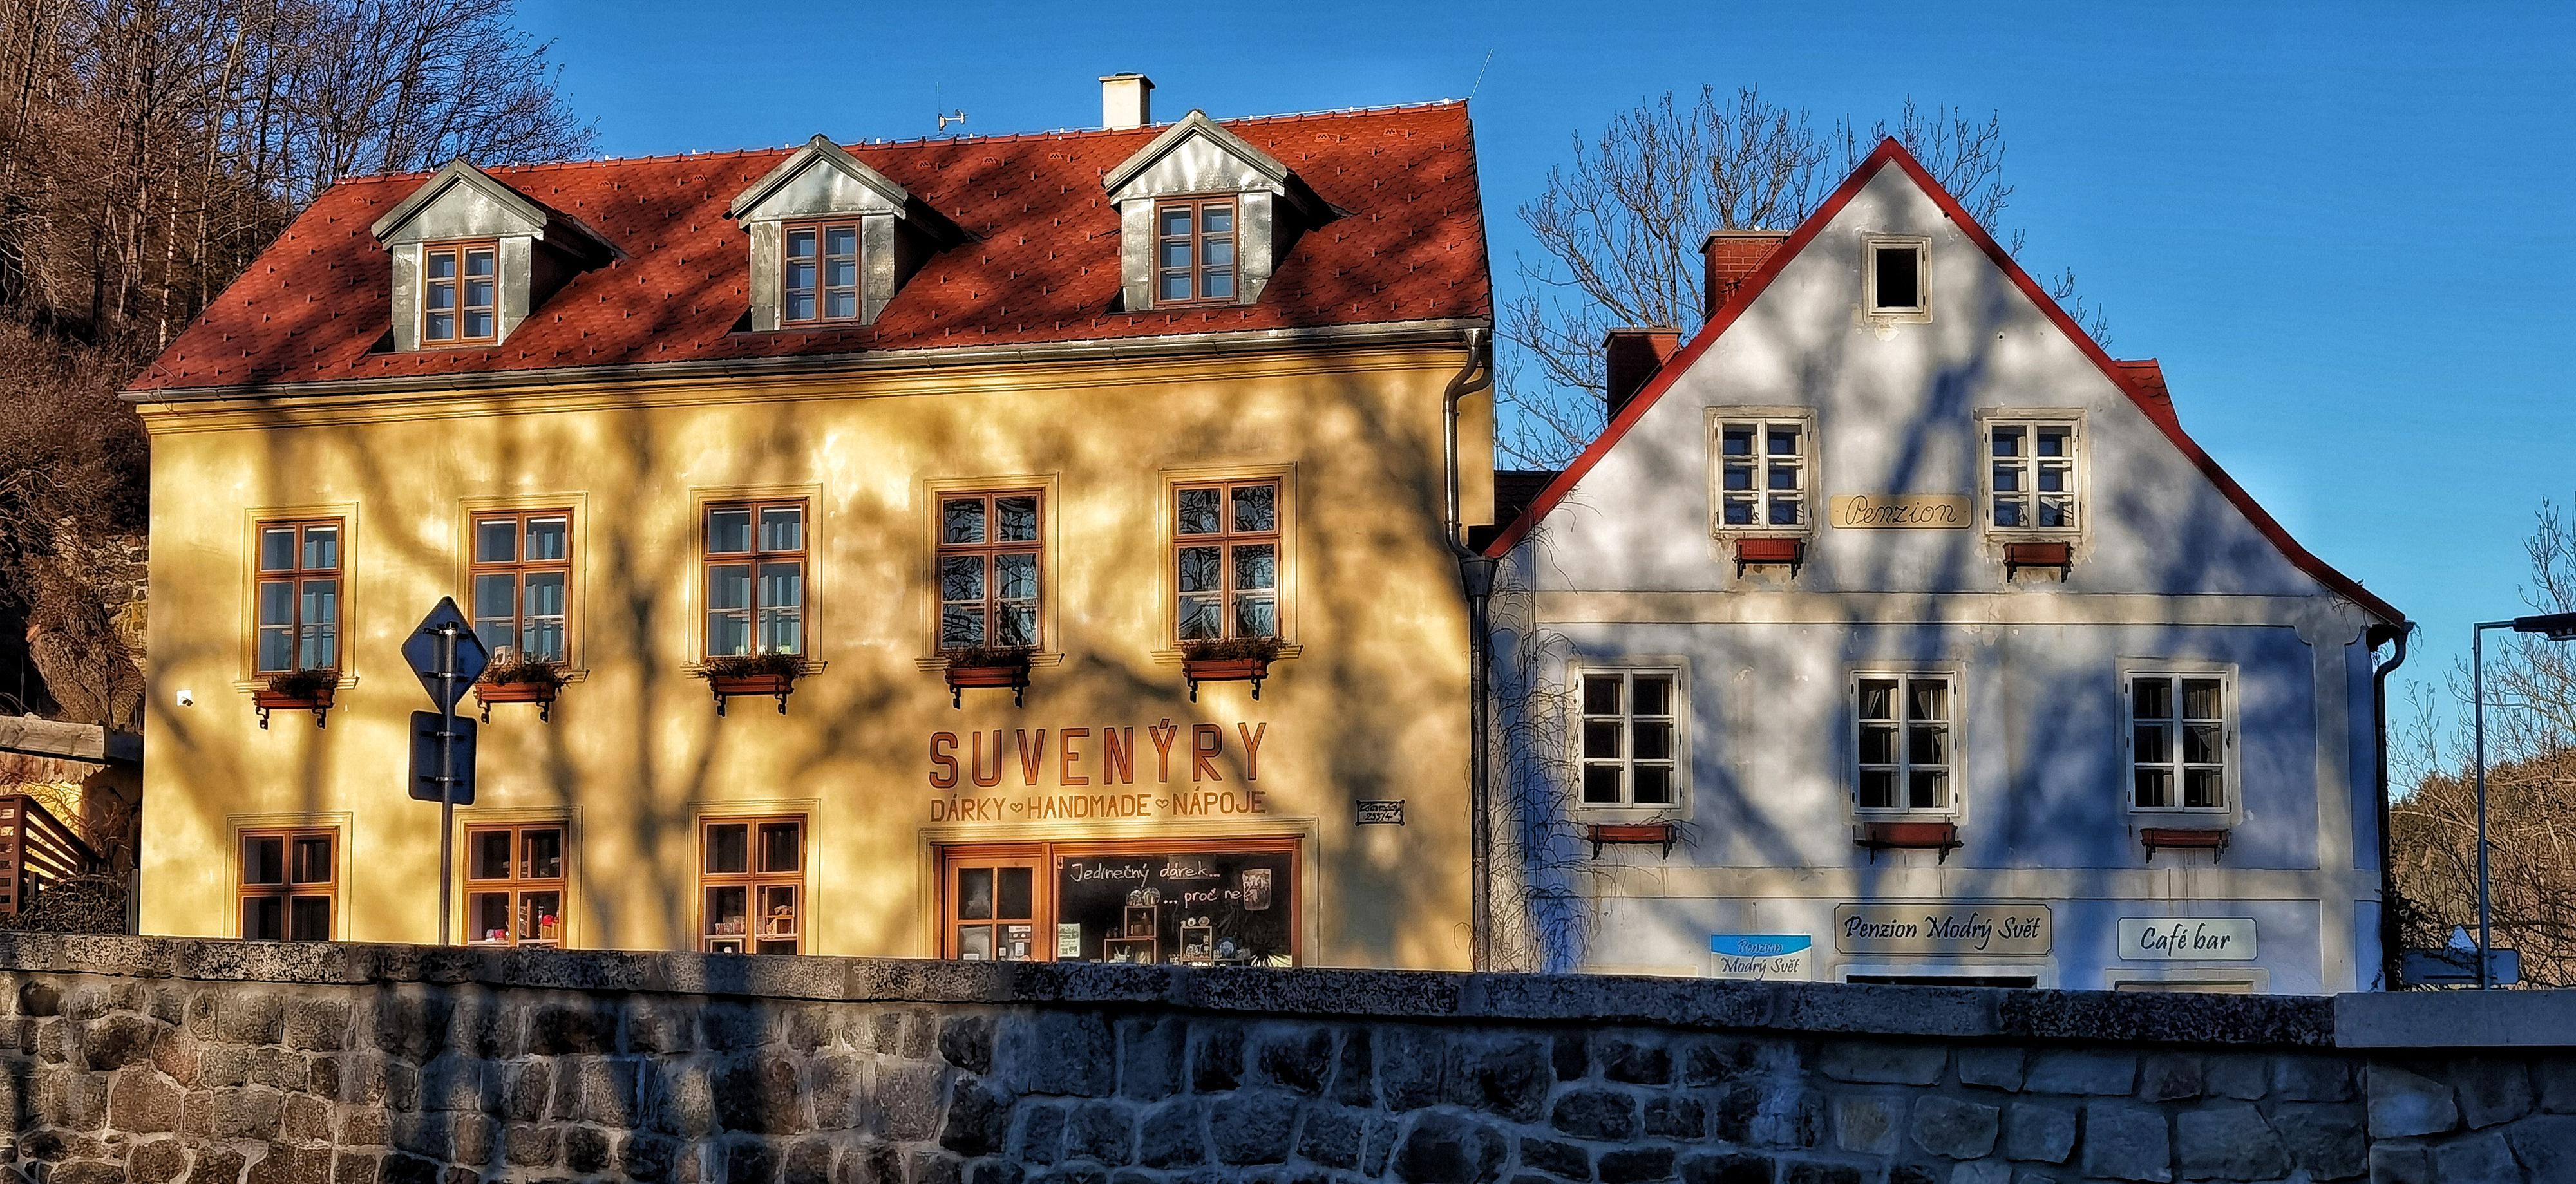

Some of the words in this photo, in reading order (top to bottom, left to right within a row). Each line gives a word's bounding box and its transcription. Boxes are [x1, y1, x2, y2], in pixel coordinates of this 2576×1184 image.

[1845, 495, 1957, 525] Penzion
[929, 719, 1266, 789] SUVENÝRY
[931, 794, 1007, 822] DÁRKY
[1027, 794, 1151, 819] HANDMADE
[1173, 786, 1266, 816] NÁPOJE
[1070, 863, 1150, 889] Jedinečný
[1738, 939, 1783, 953] Penzion
[1844, 916, 1917, 938] Penzion
[1925, 912, 1992, 950] Modrý
[1998, 917, 2041, 939] Svět
[2141, 923, 2188, 957] Café
[2193, 923, 2230, 950] bar
[1721, 955, 1766, 981] Modrý
[1771, 957, 1800, 973] Svět
